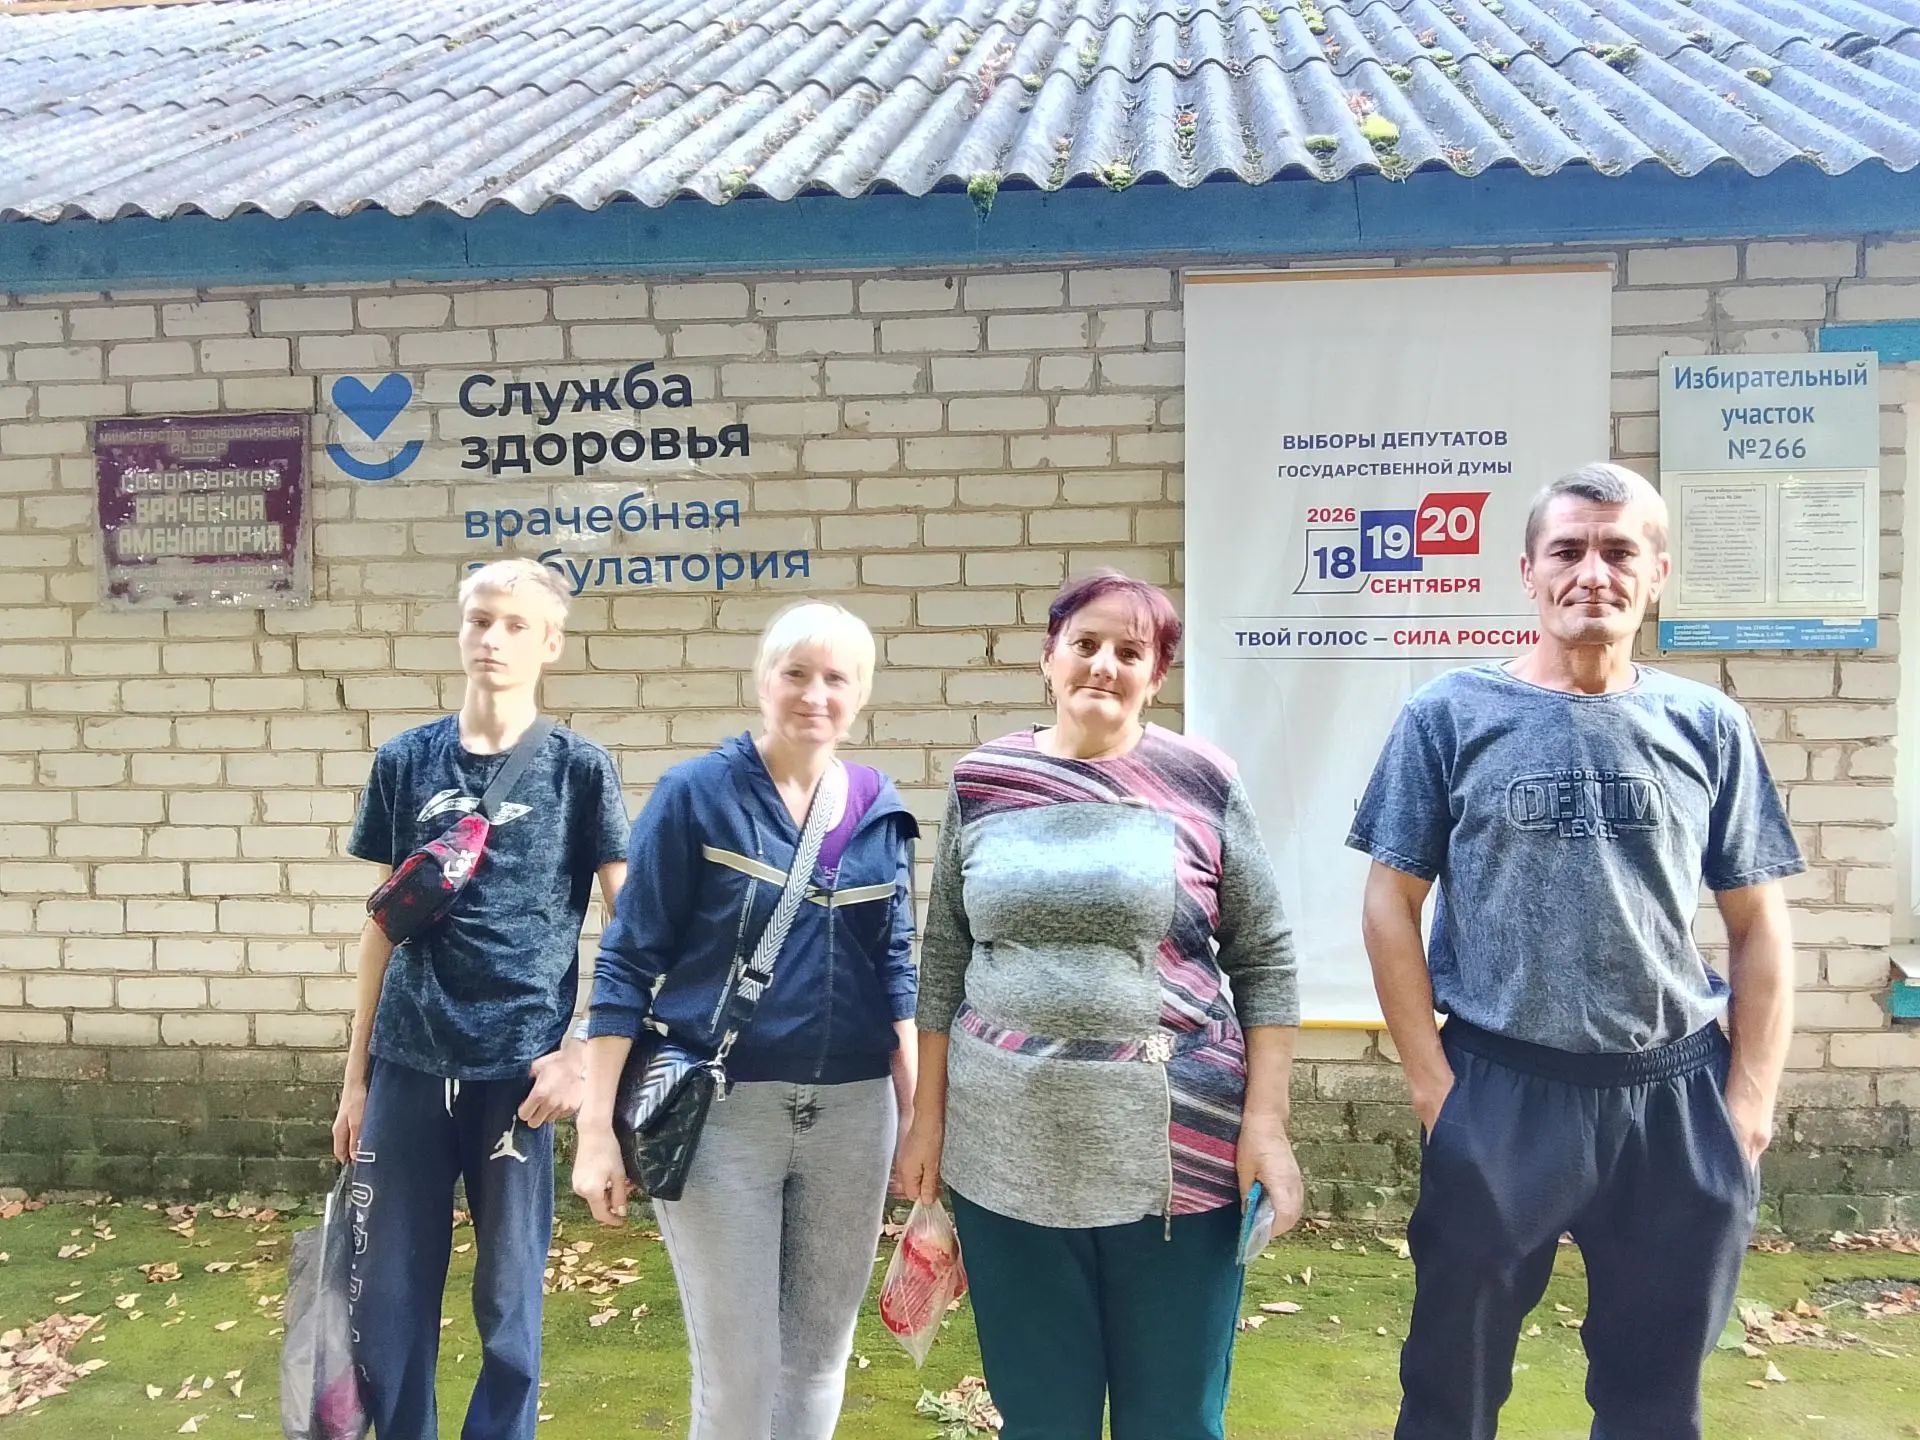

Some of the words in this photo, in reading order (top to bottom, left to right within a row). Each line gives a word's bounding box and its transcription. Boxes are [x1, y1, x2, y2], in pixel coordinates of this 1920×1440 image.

[1675, 362, 1868, 394] Избирательный
[459, 362, 692, 425] Служба
[1721, 406, 1815, 431] участок
[460, 424, 750, 475] здоровья
[1283, 433, 1376, 450] ВЫБОРЫ
[1382, 430, 1508, 450] ДЕПУТАТОВ
[1728, 438, 1807, 460] №266
[1278, 459, 1453, 479] ГОСУДАРСТВЕННОЙ
[1457, 461, 1512, 476] ДУМЫ
[136, 494, 265, 523] ВРАЧЕБНАЯ
[465, 492, 740, 545] врачебная
[1307, 507, 1356, 522] 2026
[119, 525, 281, 553] АМБУЛАТОРИЯ
[1313, 546, 1356, 579] 18
[1366, 525, 1410, 560] 19
[1421, 506, 1475, 542] 20
[468, 548, 810, 595] улатория
[1370, 577, 1481, 594] СЕНТЯБРЯ
[1235, 628, 1291, 646] ТВОЙ
[1297, 630, 1368, 646] ГОЛОС
[1393, 630, 1451, 645] СИЛА
[1554, 770, 1615, 780] WORLD
[1516, 782, 1659, 821] DENIM
[1558, 820, 1619, 838] LEVEL
